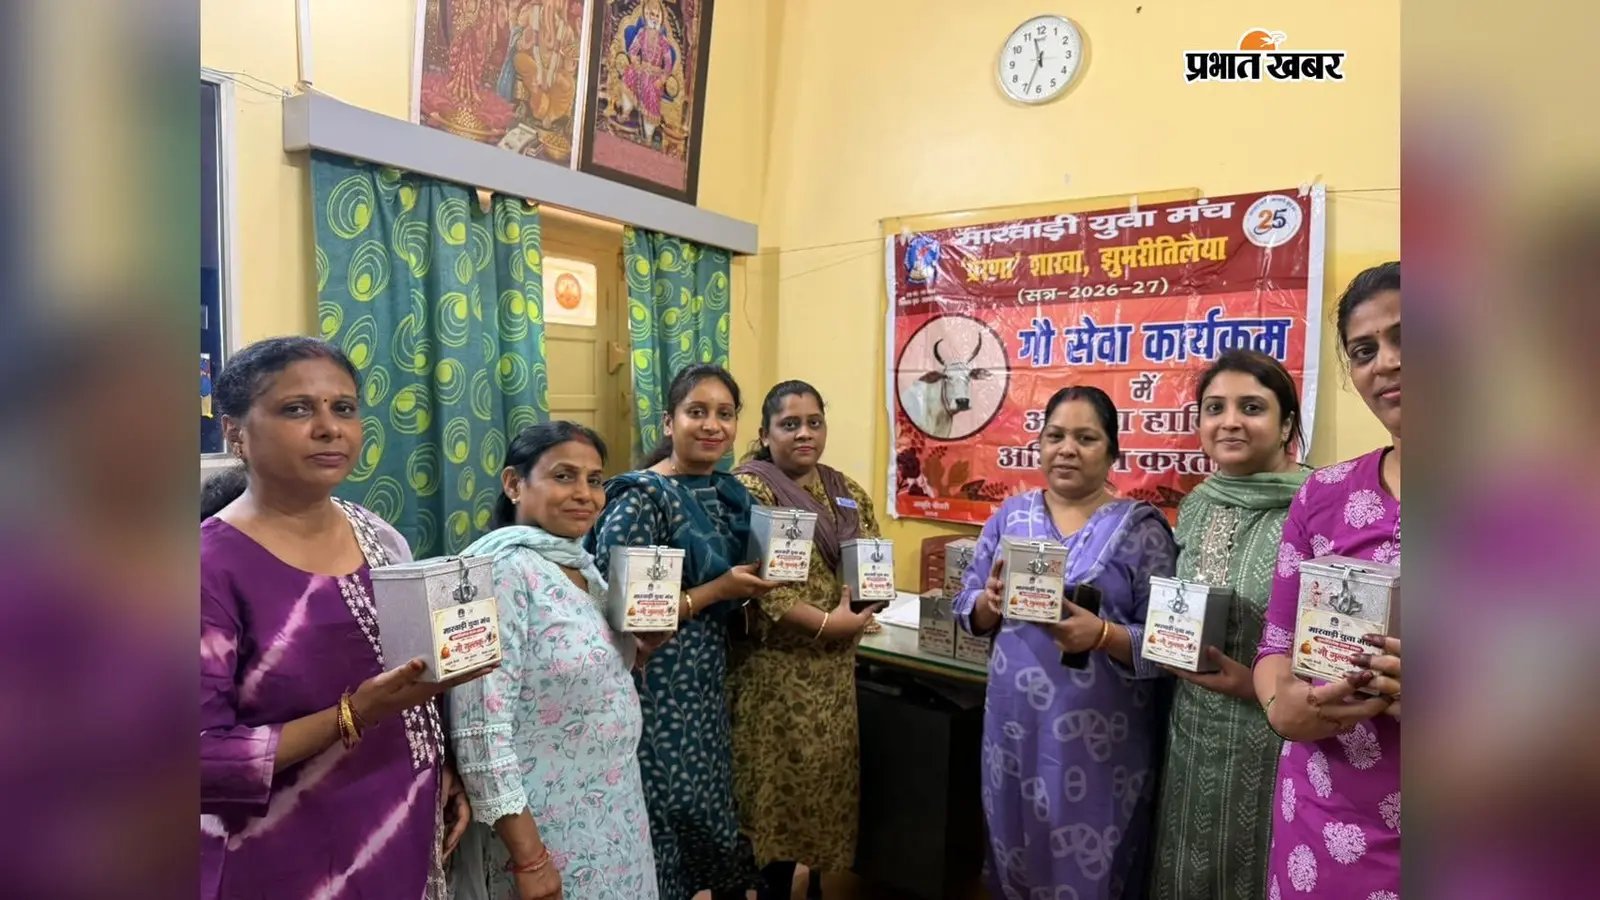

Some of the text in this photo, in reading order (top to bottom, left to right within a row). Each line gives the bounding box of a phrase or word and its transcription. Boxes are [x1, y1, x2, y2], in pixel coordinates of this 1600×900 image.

[1036, 25, 1047, 35] 12
[1053, 27, 1058, 36] 1
[1023, 32, 1032, 42] 11
[1062, 35, 1069, 45] 2
[1013, 45, 1022, 55] 10
[1065, 50, 1072, 59] 3
[1009, 60, 1016, 70] 9
[1061, 65, 1067, 74] 4
[1012, 74, 1018, 83] 8
[1050, 78, 1056, 87] 5
[1022, 82, 1028, 92] 7
[1035, 85, 1042, 93] 6
[955, 213, 1079, 247] मारवाड़ी
[1089, 209, 1157, 241] युवा
[1166, 198, 1236, 223] मंच
[1258, 208, 1288, 230] 25
[1099, 232, 1229, 279] झुमरीतिलैया
[1018, 317, 1056, 366] गौ
[1064, 315, 1134, 364] सेवा
[1130, 374, 1160, 401] में
[1308, 626, 1338, 639] मारवाड़ी
[1339, 632, 1356, 643] युवा
